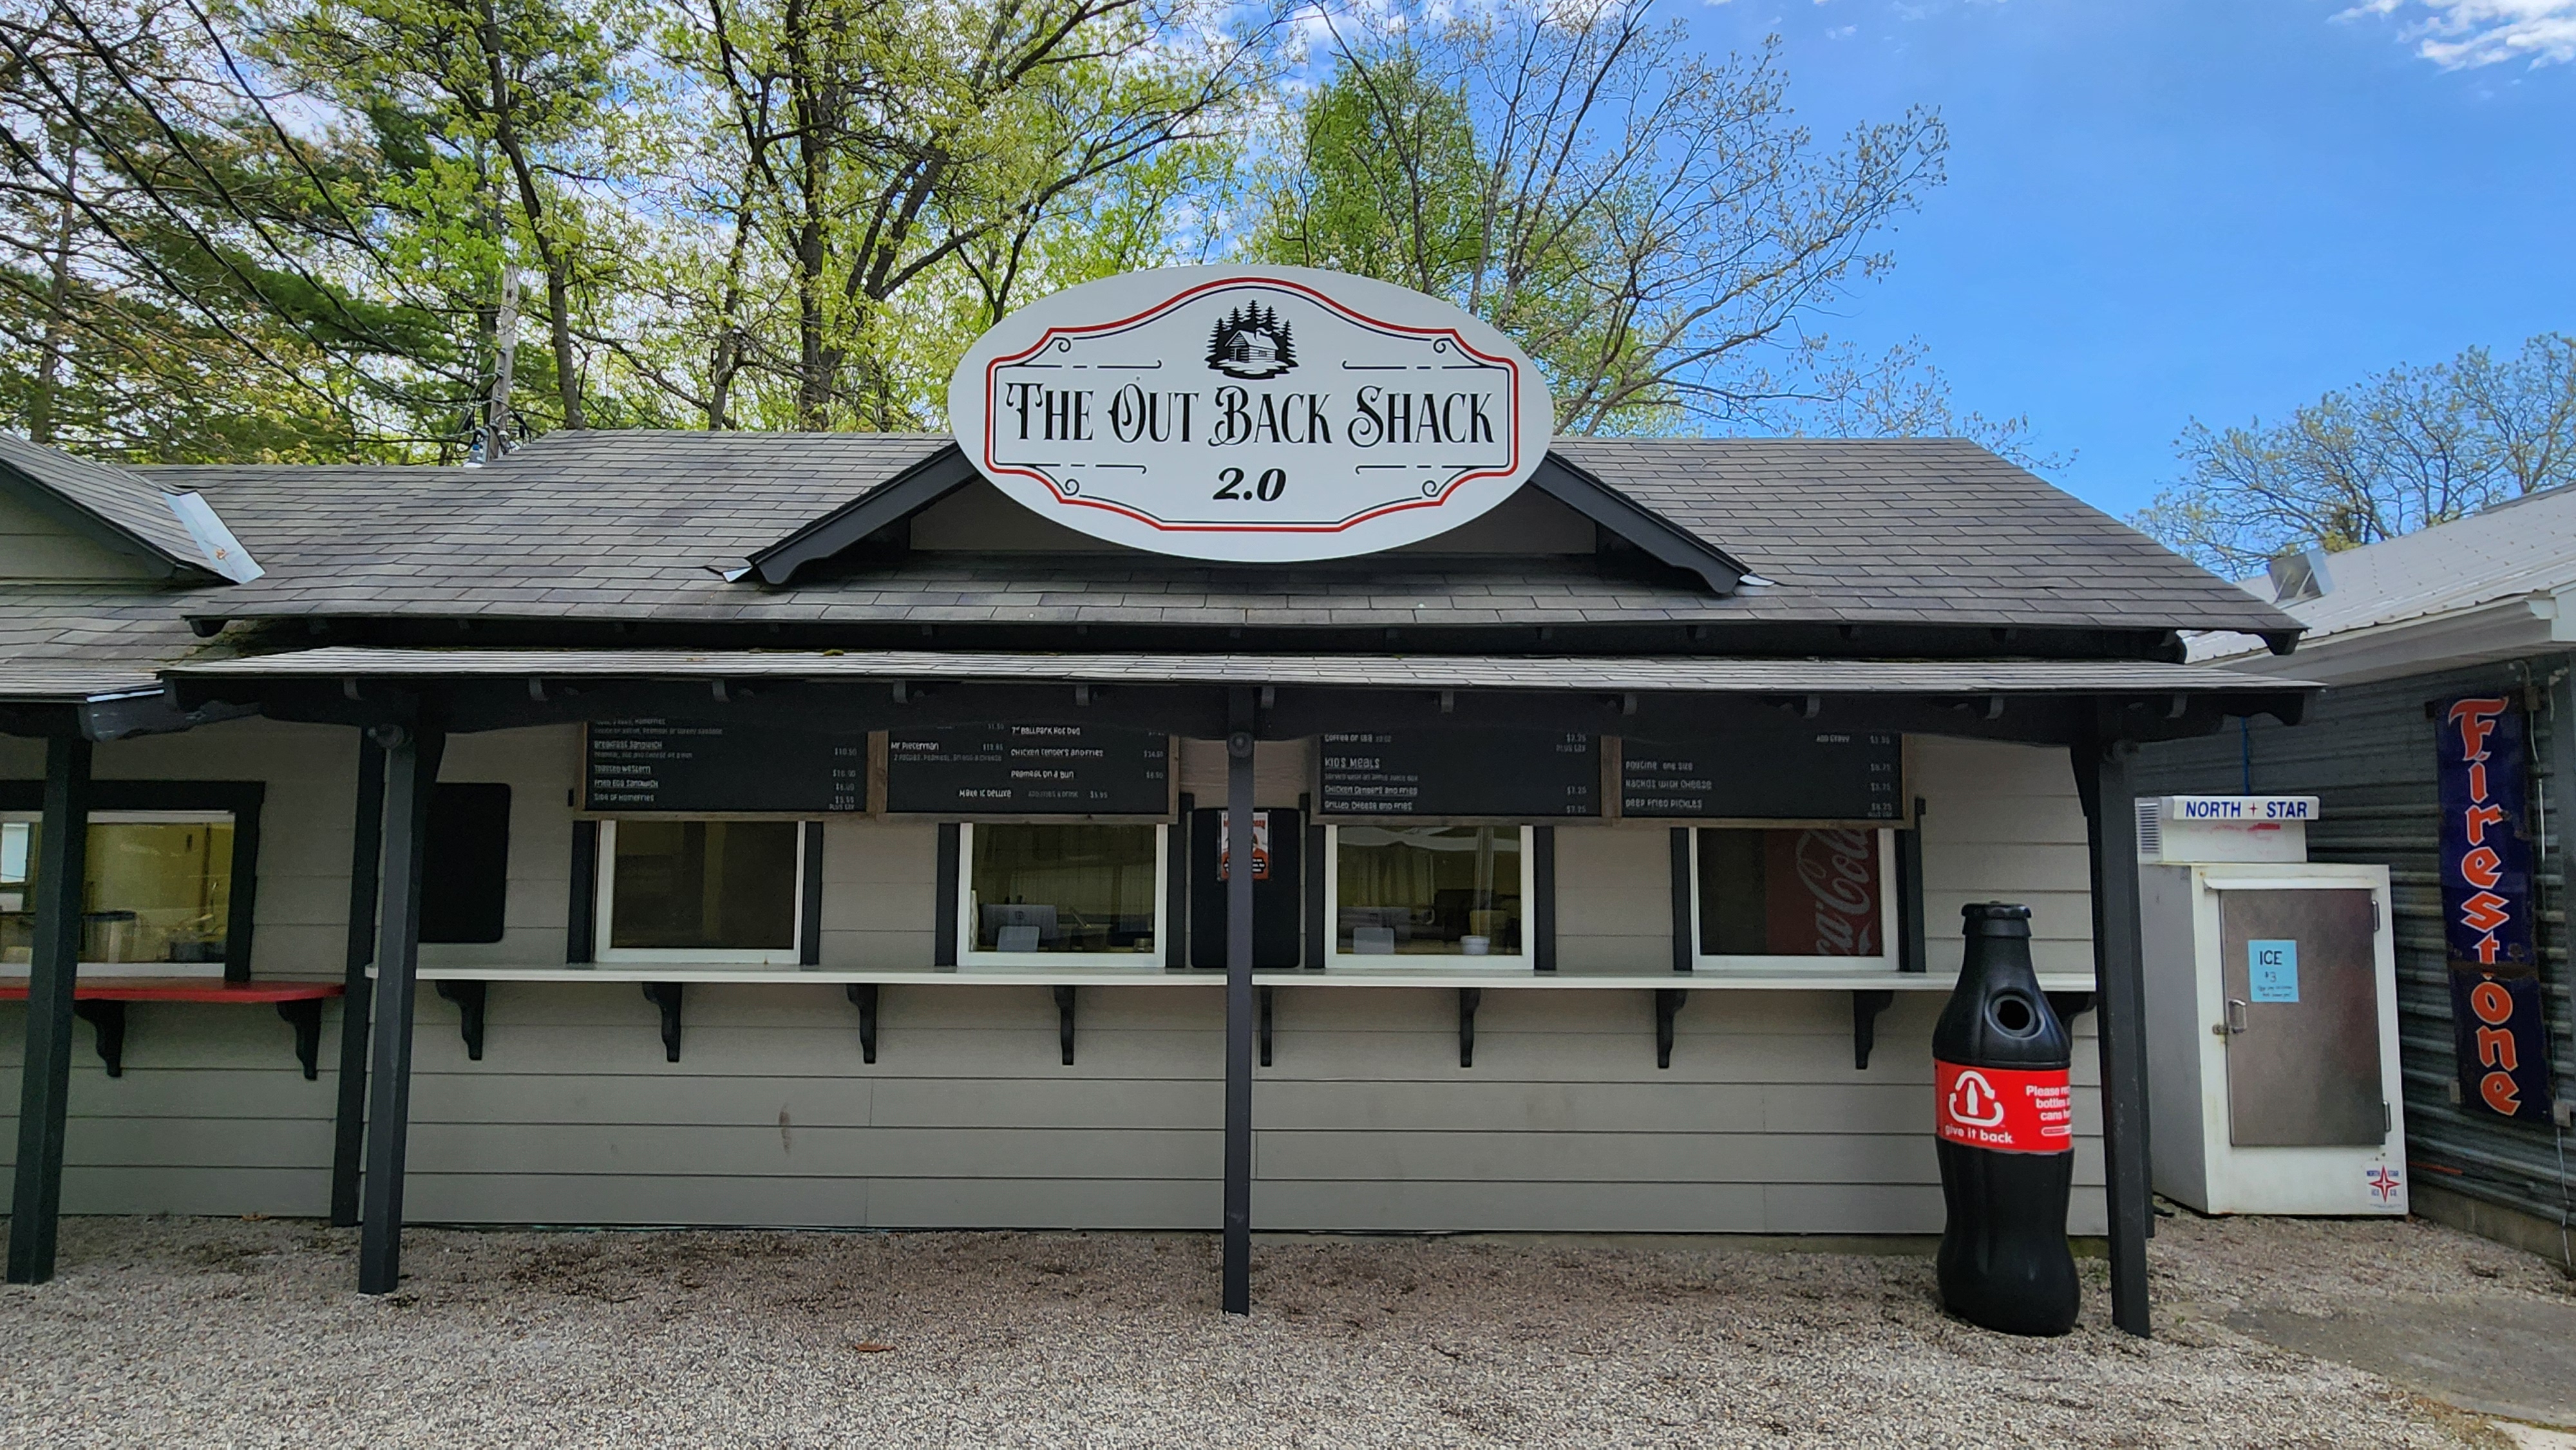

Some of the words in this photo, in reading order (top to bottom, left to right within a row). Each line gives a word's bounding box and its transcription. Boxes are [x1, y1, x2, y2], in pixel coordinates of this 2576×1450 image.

[1005, 382, 1094, 440] THE
[1107, 382, 1199, 443] OUT
[1208, 385, 1332, 447] BACK
[1347, 385, 1495, 448] SHACK
[1212, 467, 1287, 502] 2.0
[2186, 802, 2241, 818] NORTH
[2266, 802, 2307, 818] STAR
[2448, 697, 2521, 1115] Firestone
[2259, 950, 2282, 965] ICE
[2026, 1085, 2060, 1097] Please
[2040, 1111, 2062, 1121] cans
[1945, 1124, 1964, 1137] give
[1967, 1127, 1976, 1139] it
[1980, 1129, 2014, 1144] back
